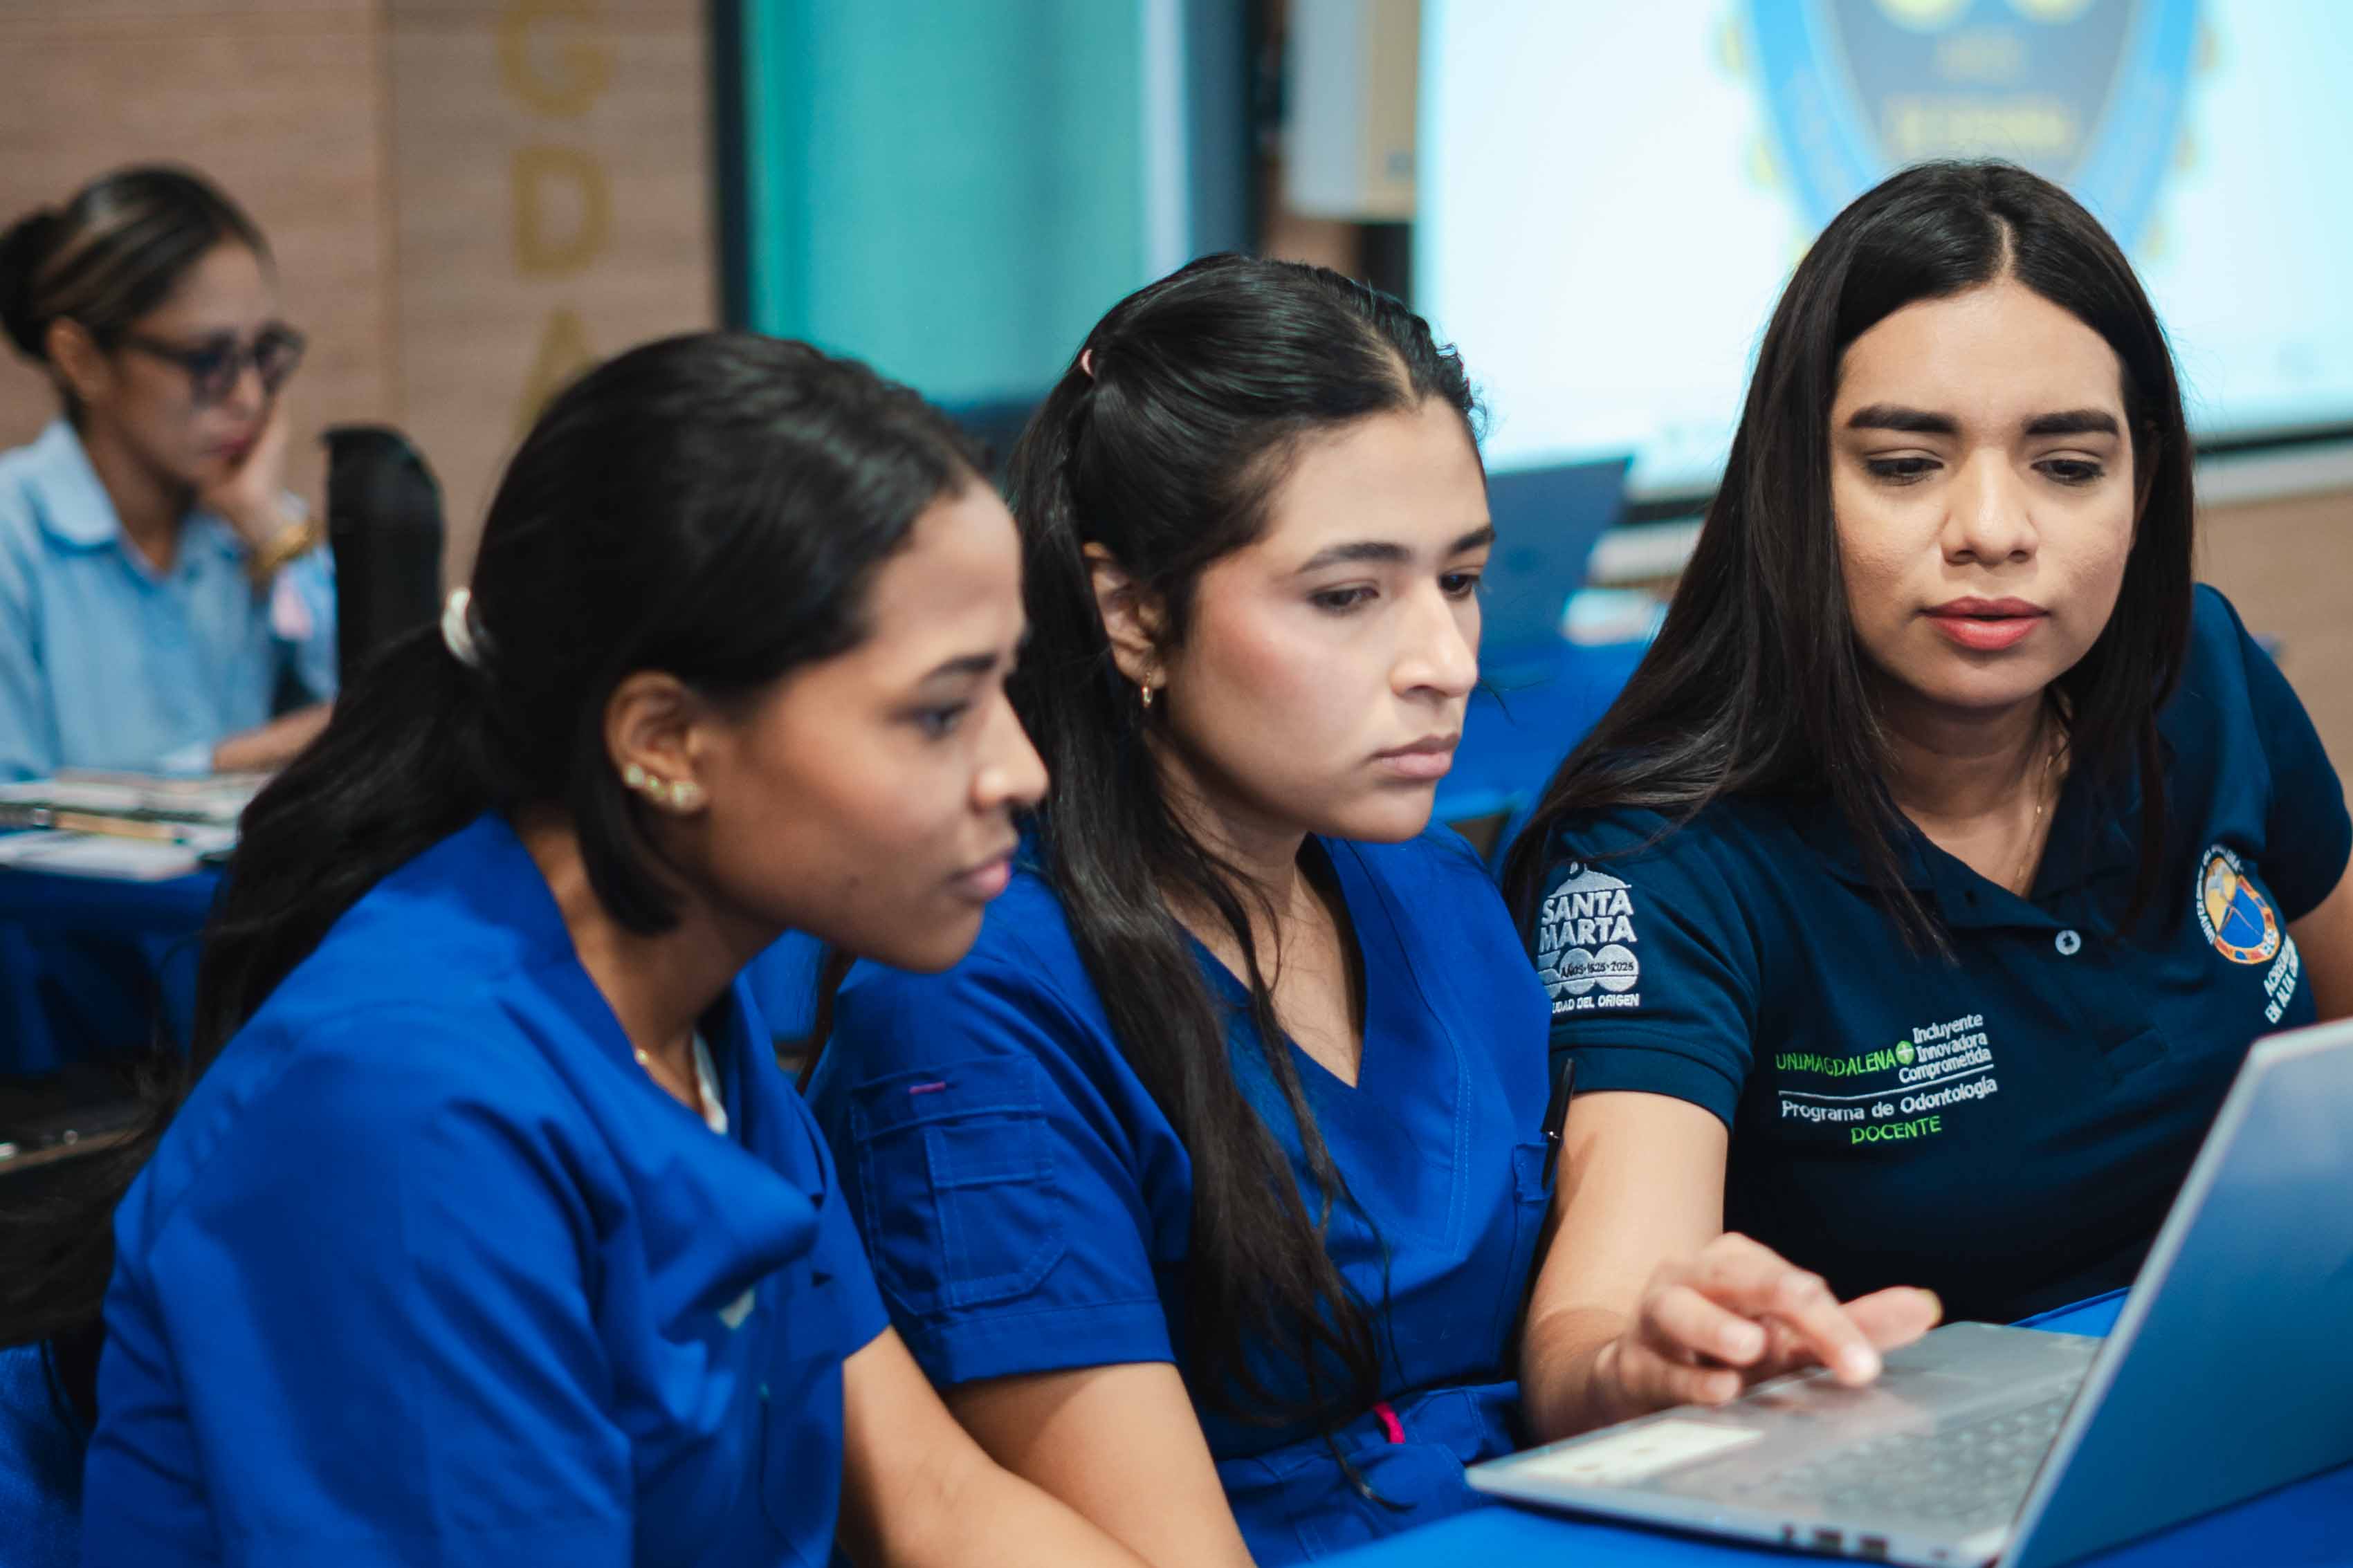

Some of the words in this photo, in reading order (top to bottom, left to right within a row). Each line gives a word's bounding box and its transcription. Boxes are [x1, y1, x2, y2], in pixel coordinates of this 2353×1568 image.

[1541, 889, 1634, 925] SANTA
[1539, 915, 1638, 953] MARTA
[1552, 997, 1575, 1014] UDAD
[1577, 996, 1595, 1009] DEL
[1597, 993, 1639, 1008] ORIGEN
[1912, 1013, 1984, 1044] Incluyente
[1775, 1048, 1897, 1077] UNIMAGDALENA
[1915, 1032, 1988, 1063] Innovadora
[1898, 1047, 1993, 1084] Comprometida
[1782, 1100, 1866, 1122] Programa
[1871, 1102, 1894, 1118] de
[1900, 1076, 1998, 1114] Odontología
[1851, 1115, 1942, 1145] DOCENTE
